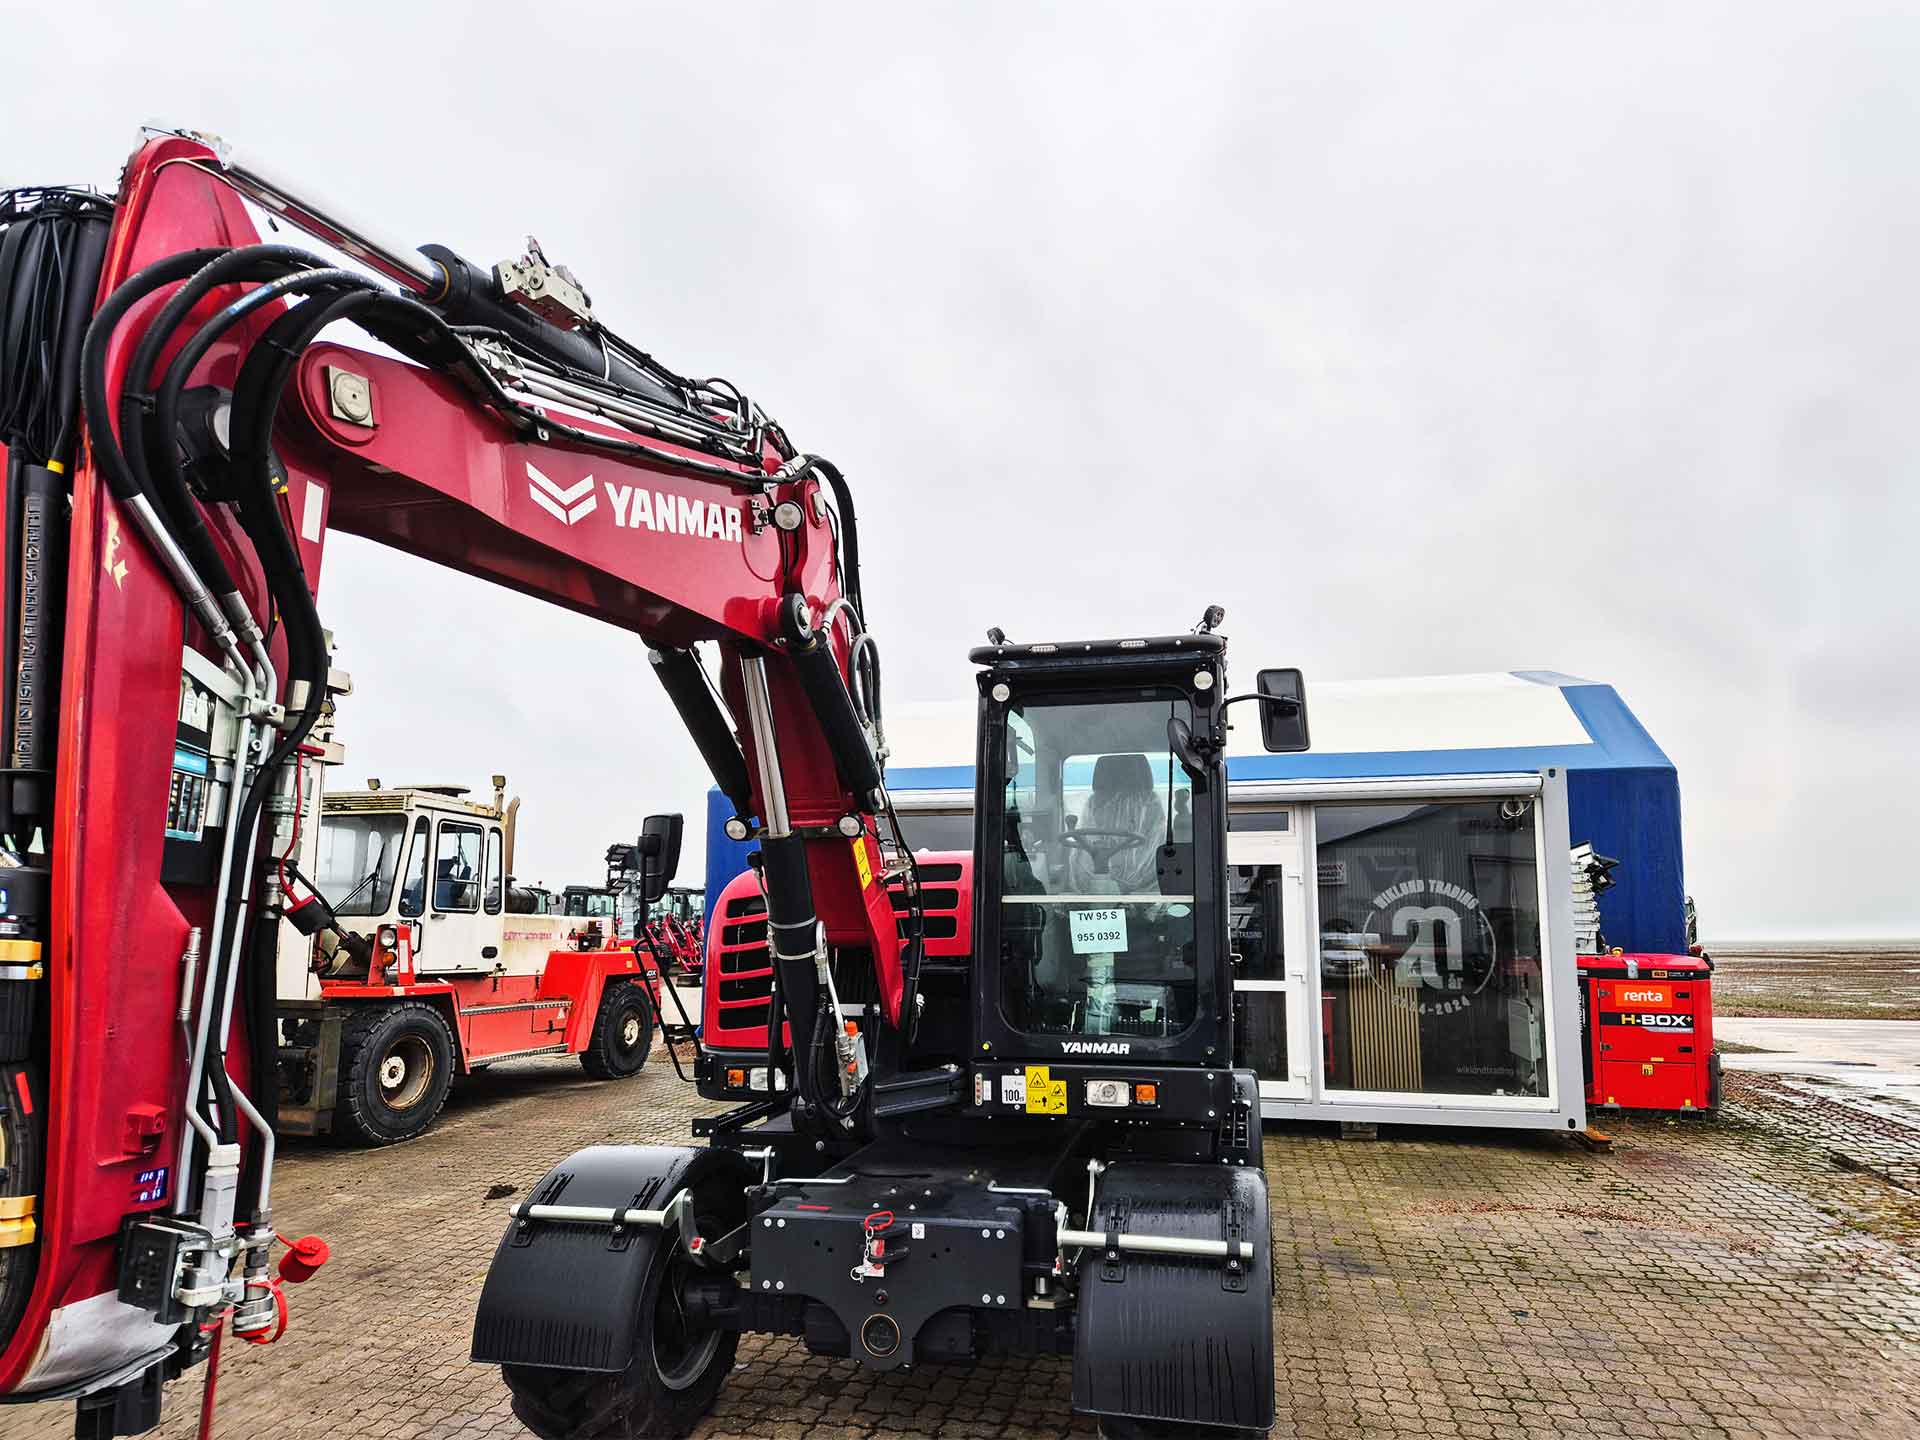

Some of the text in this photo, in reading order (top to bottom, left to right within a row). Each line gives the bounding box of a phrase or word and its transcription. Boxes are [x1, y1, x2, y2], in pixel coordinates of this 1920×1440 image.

[603, 481, 743, 543] YANMAR
[1428, 879, 1480, 910] TRADING
[1078, 910, 1118, 921] TW 95 S
[1077, 931, 1121, 942] 955 0392
[1623, 990, 1664, 1002] renta
[1060, 1041, 1131, 1055] YANMAR
